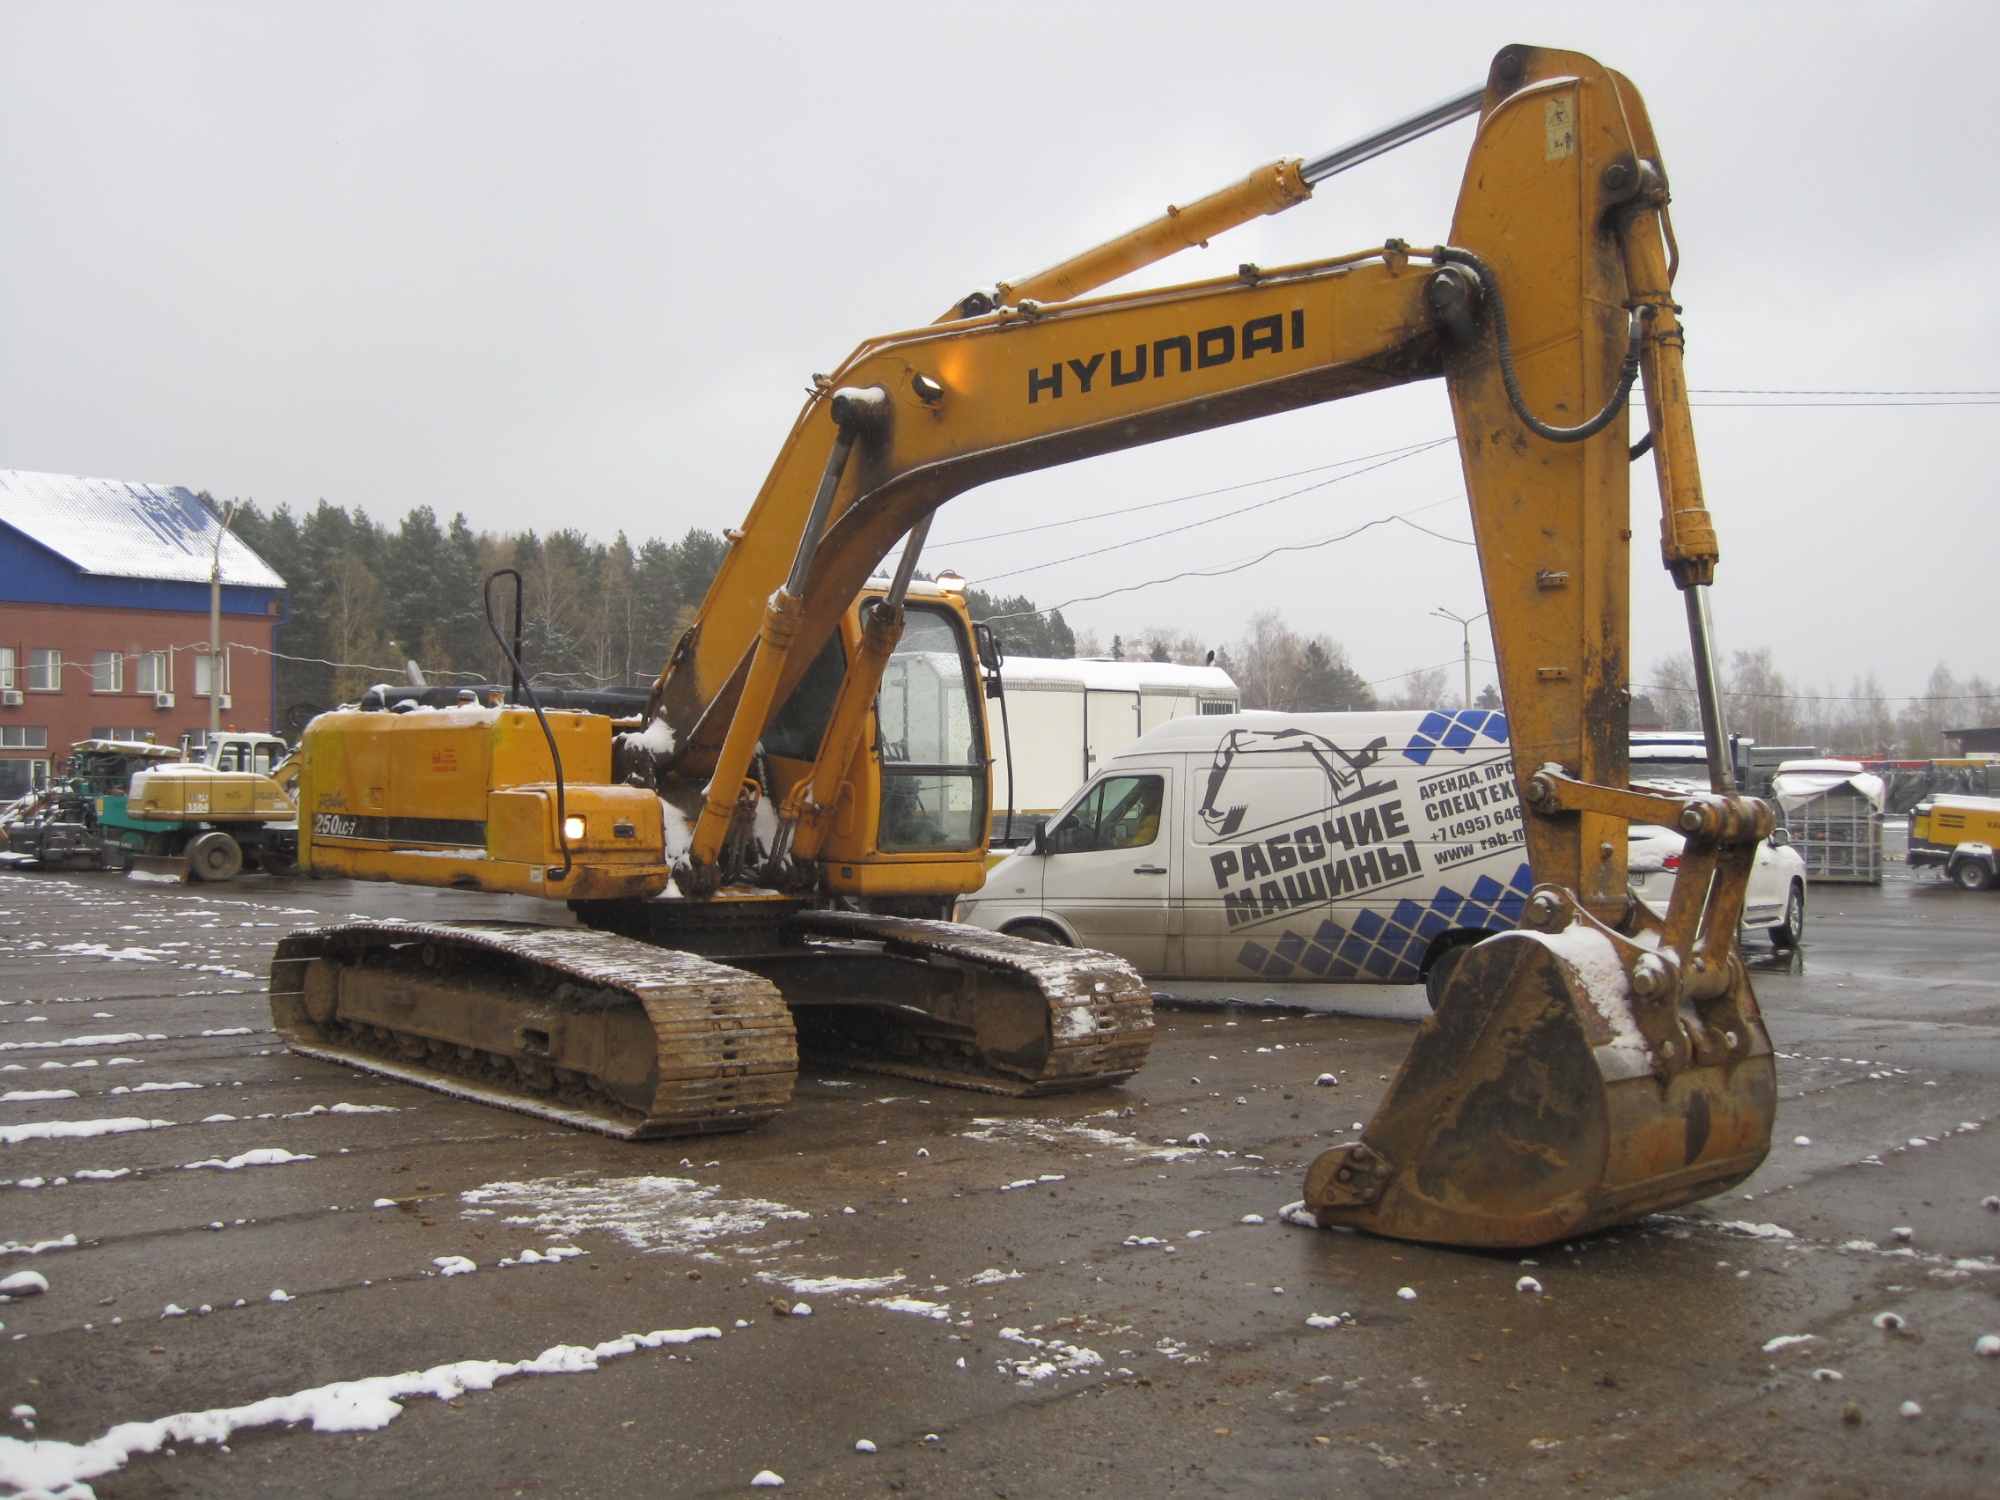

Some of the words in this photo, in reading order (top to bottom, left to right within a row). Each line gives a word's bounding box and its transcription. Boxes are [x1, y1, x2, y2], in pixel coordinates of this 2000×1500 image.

[1028, 308, 1305, 404] HYUNDAI
[1419, 770, 1484, 801] АРЕНДА,
[314, 813, 357, 836] 250LC-7
[1209, 798, 1411, 890] РАБОЧИЕ
[1430, 827, 1447, 842] +7
[1449, 814, 1492, 839] (495)
[1223, 839, 1423, 927] МАШИНЫ
